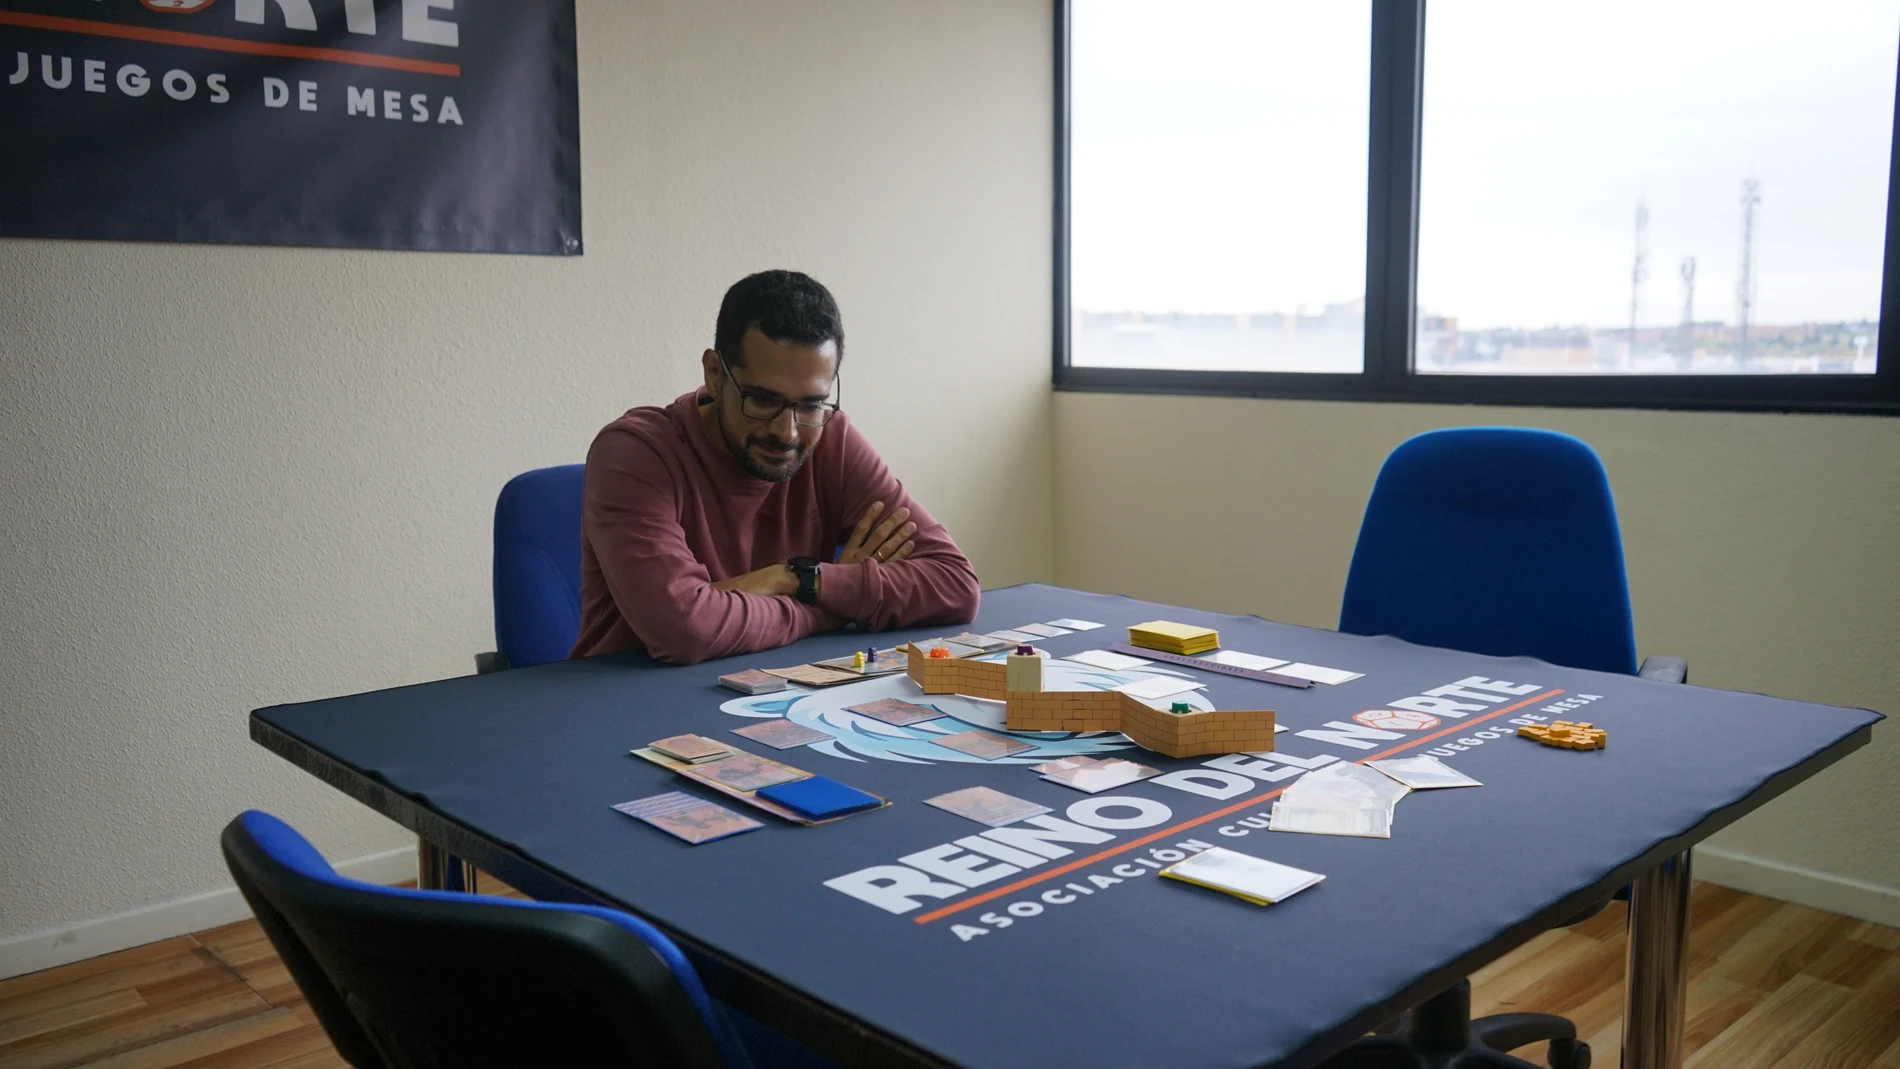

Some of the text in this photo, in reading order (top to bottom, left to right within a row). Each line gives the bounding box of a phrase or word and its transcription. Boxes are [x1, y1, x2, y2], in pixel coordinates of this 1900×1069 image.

[10, 52, 464, 126] JUEGOS DE MESA
[1164, 654, 1245, 674] CONSTRUCCIONES
[823, 796, 1172, 914] REINO
[1149, 752, 1341, 800] DEL
[950, 839, 1214, 942] ASOCIACIÓN
[1508, 714, 1548, 726] DE
[1540, 694, 1603, 713] MESA
